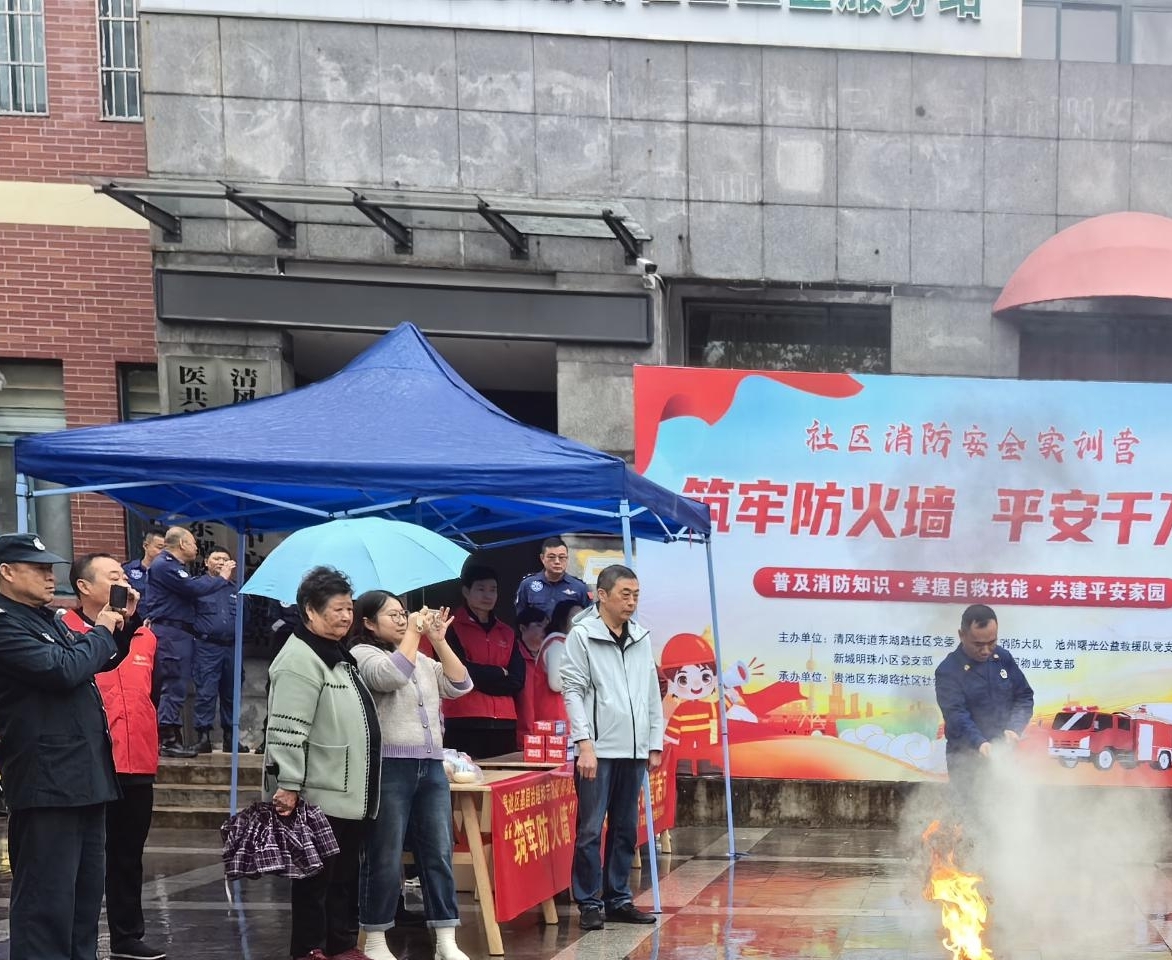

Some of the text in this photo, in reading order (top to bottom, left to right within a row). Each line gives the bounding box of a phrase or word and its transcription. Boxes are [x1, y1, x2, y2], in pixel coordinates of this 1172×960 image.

[805, 419, 1141, 465] 社区消防安全实训营
[682, 477, 956, 539] 筑牢防火墙
